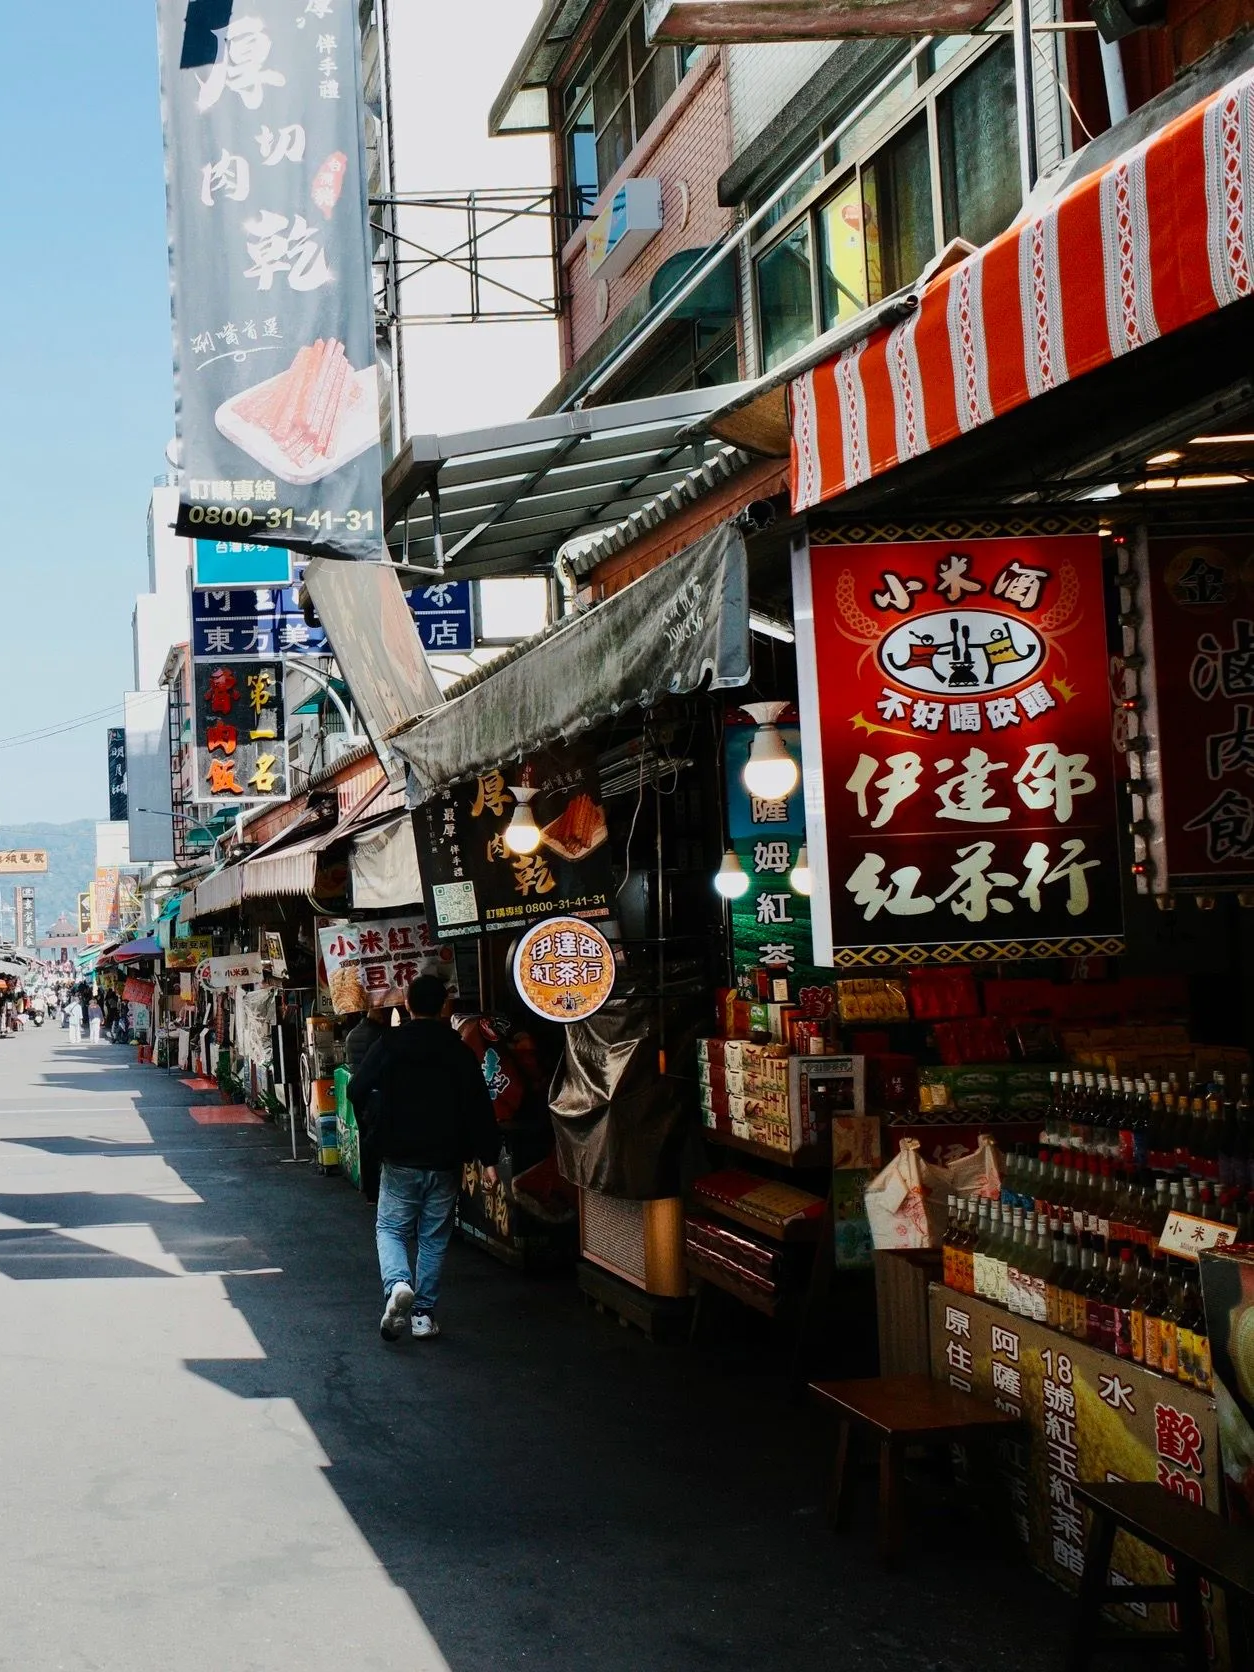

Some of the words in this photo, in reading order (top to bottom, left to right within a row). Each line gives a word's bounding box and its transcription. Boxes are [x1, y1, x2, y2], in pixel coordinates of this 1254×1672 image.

[188, 505, 375, 531] 0800-31-41-31
[874, 555, 1050, 611] 小米酒
[876, 681, 1056, 732] 不好喝砍頭
[247, 671, 282, 793] 第一名
[846, 743, 1097, 828] 伊達邵
[525, 895, 606, 914] 0800-31-41-31
[530, 931, 603, 960] 伊達邵
[530, 961, 603, 987] 紅茶行
